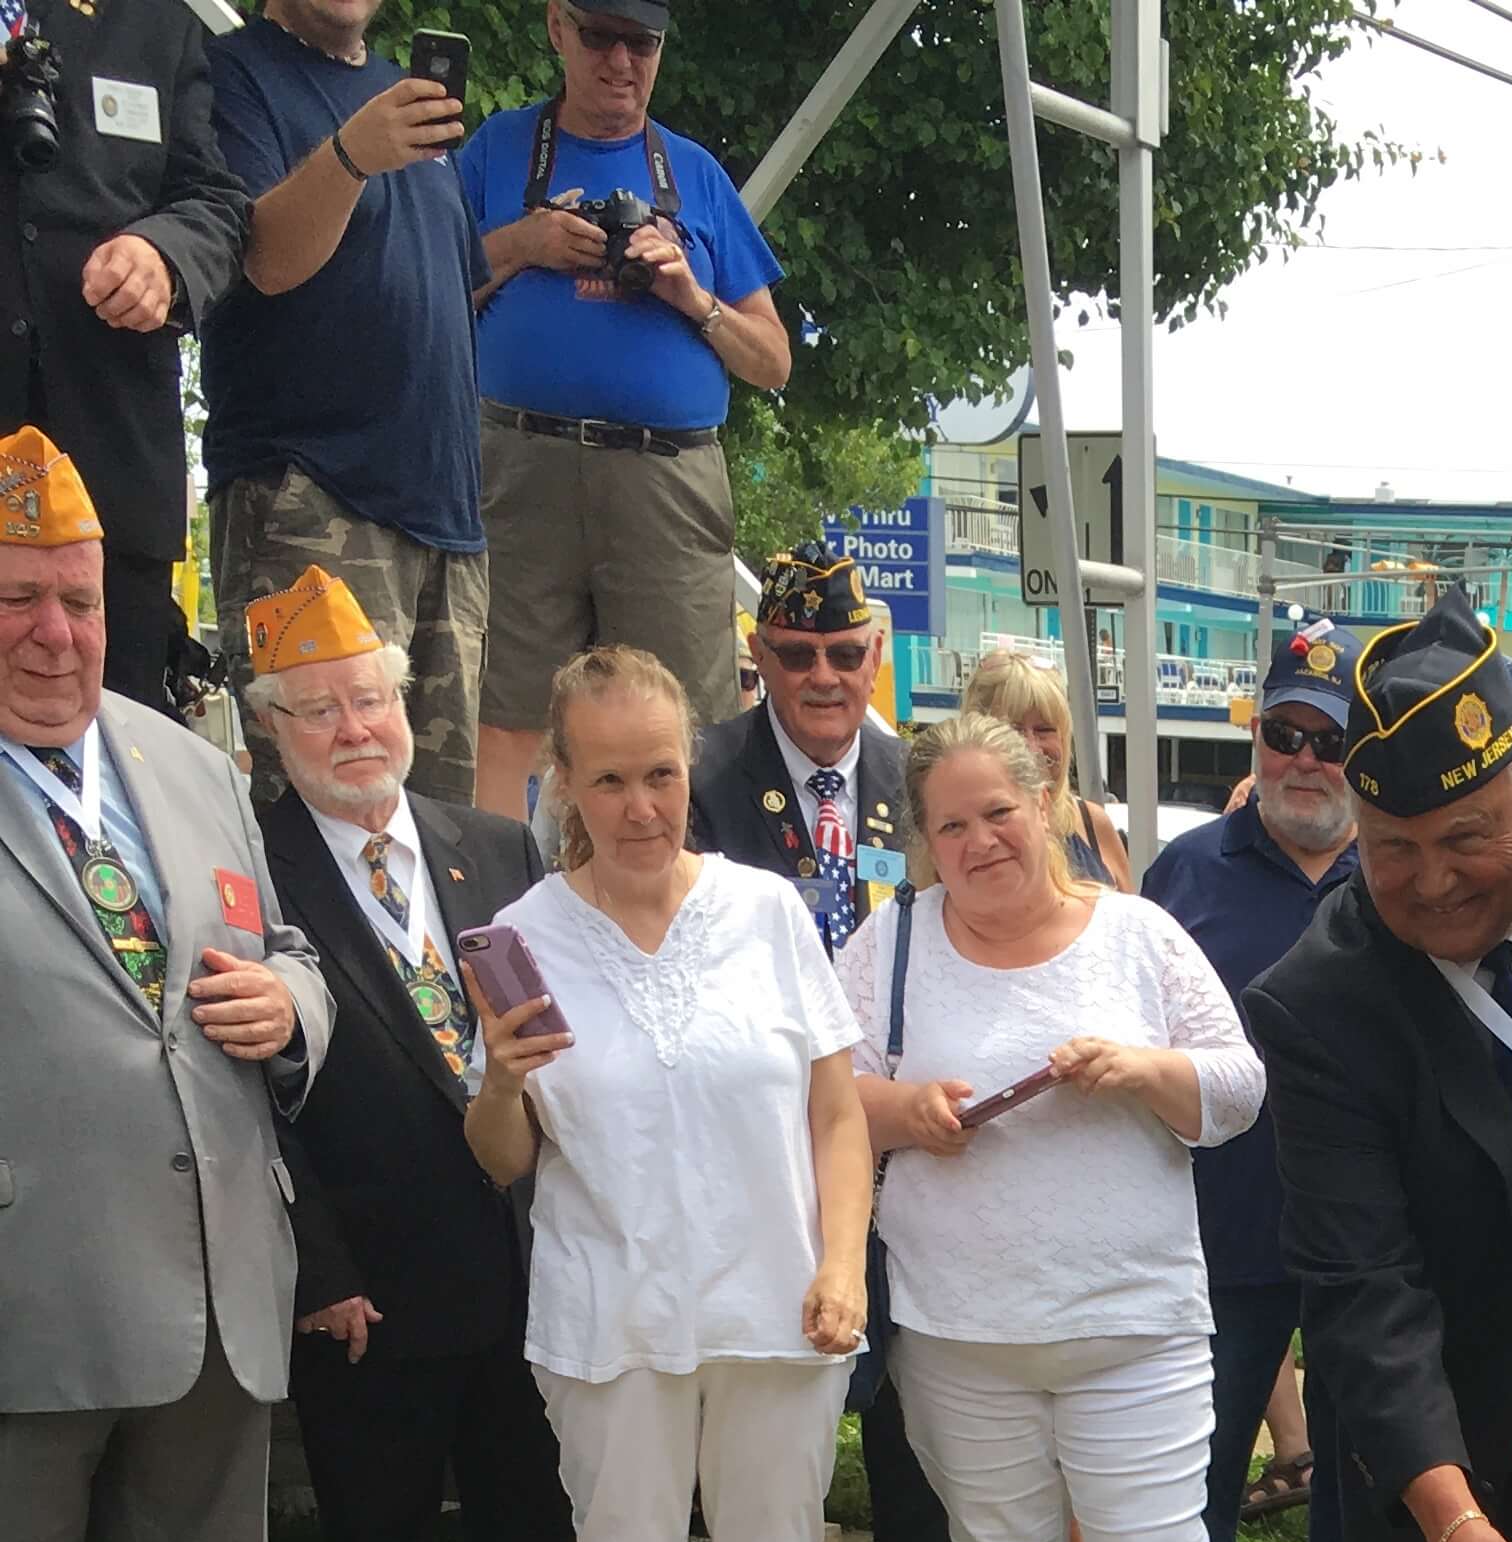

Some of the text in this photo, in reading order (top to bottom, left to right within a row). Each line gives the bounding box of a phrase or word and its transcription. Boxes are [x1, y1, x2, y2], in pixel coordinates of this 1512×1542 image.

[653, 152, 669, 189] Canon
[844, 536, 913, 560] Photo
[859, 566, 914, 589] Mart
[1359, 772, 1380, 797] 178
[1440, 759, 1478, 791] NEW
